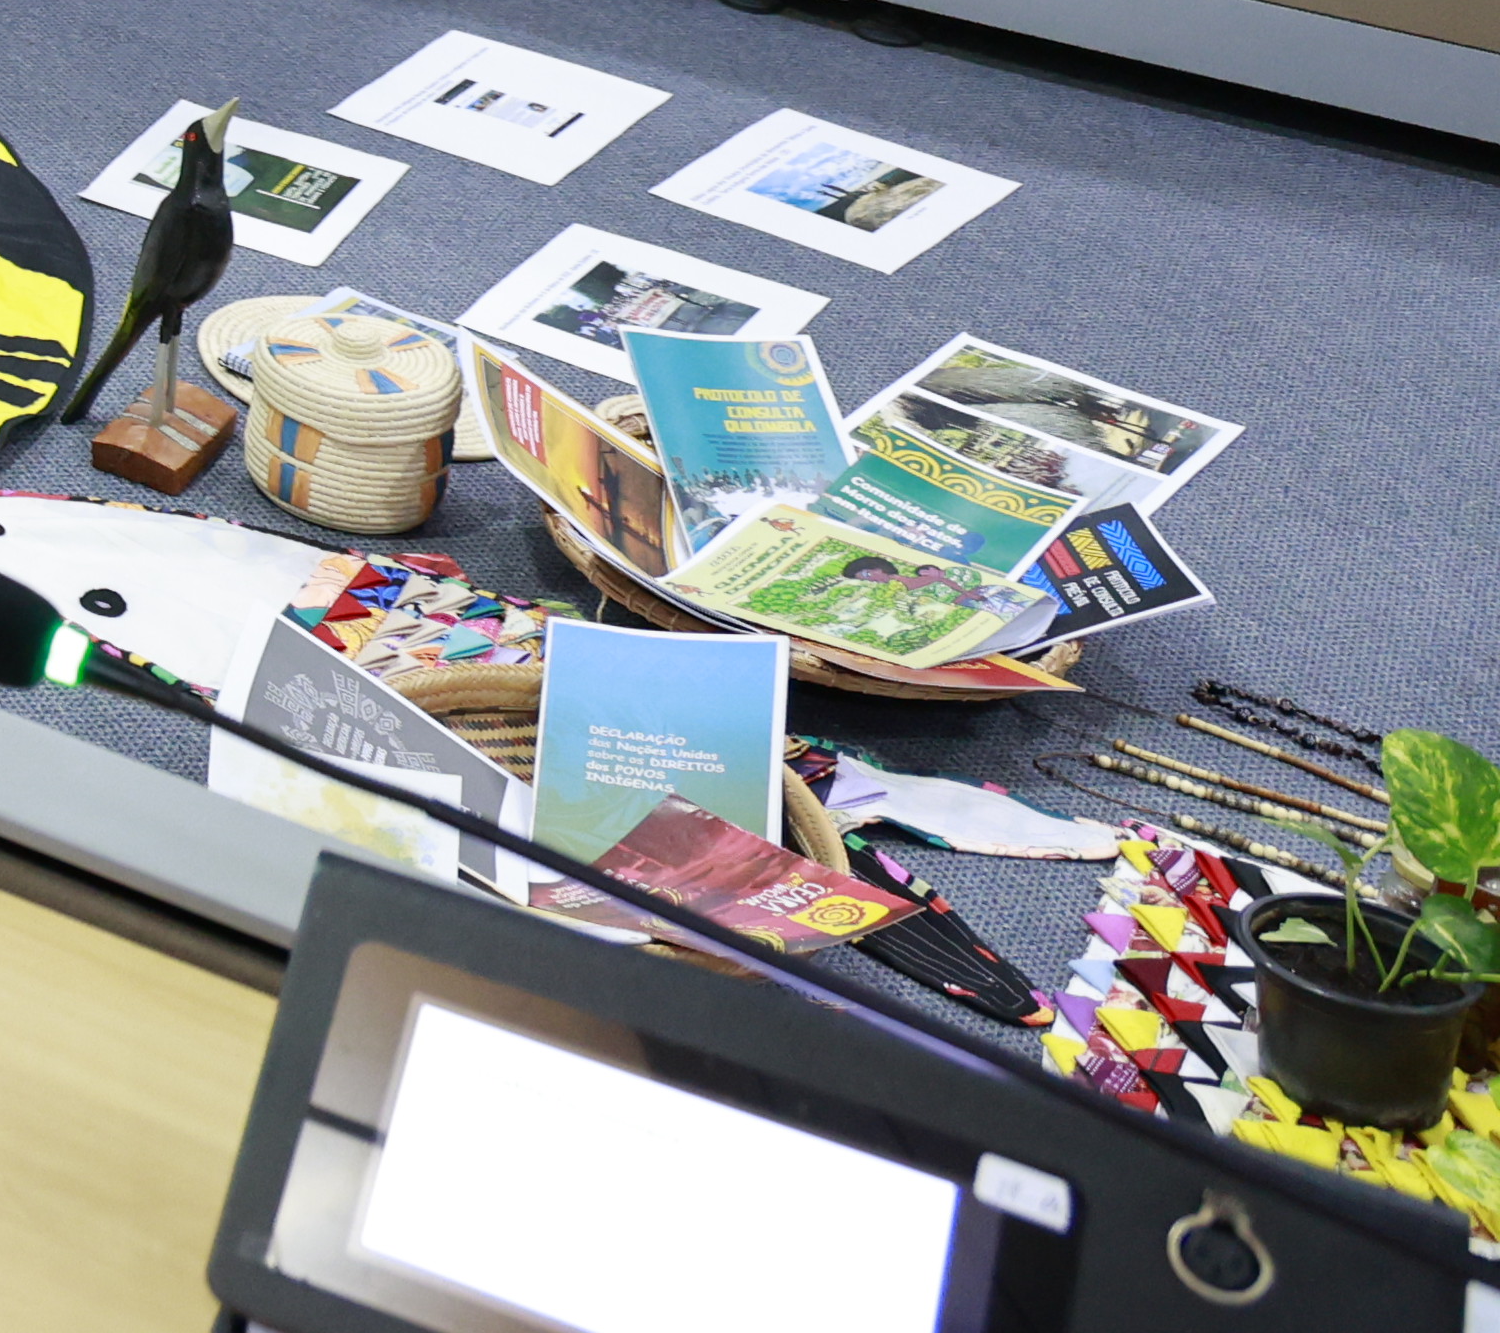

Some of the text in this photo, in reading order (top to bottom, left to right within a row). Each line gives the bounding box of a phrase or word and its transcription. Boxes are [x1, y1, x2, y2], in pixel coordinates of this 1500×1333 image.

[692, 387, 806, 403] PROTOCOLO DE
[726, 405, 806, 419] CONSULTA
[850, 476, 945, 527] Comunidade
[832, 495, 944, 552] em Itarema/CE
[840, 484, 964, 549] Morro dos Patos,
[588, 724, 687, 747] DECLARAÇÃO
[588, 737, 719, 761] das Nações Unidas
[585, 760, 667, 780] dos POVOS
[586, 749, 726, 774] sobre os DIREITOS
[584, 771, 676, 794] INDÍGENAS
